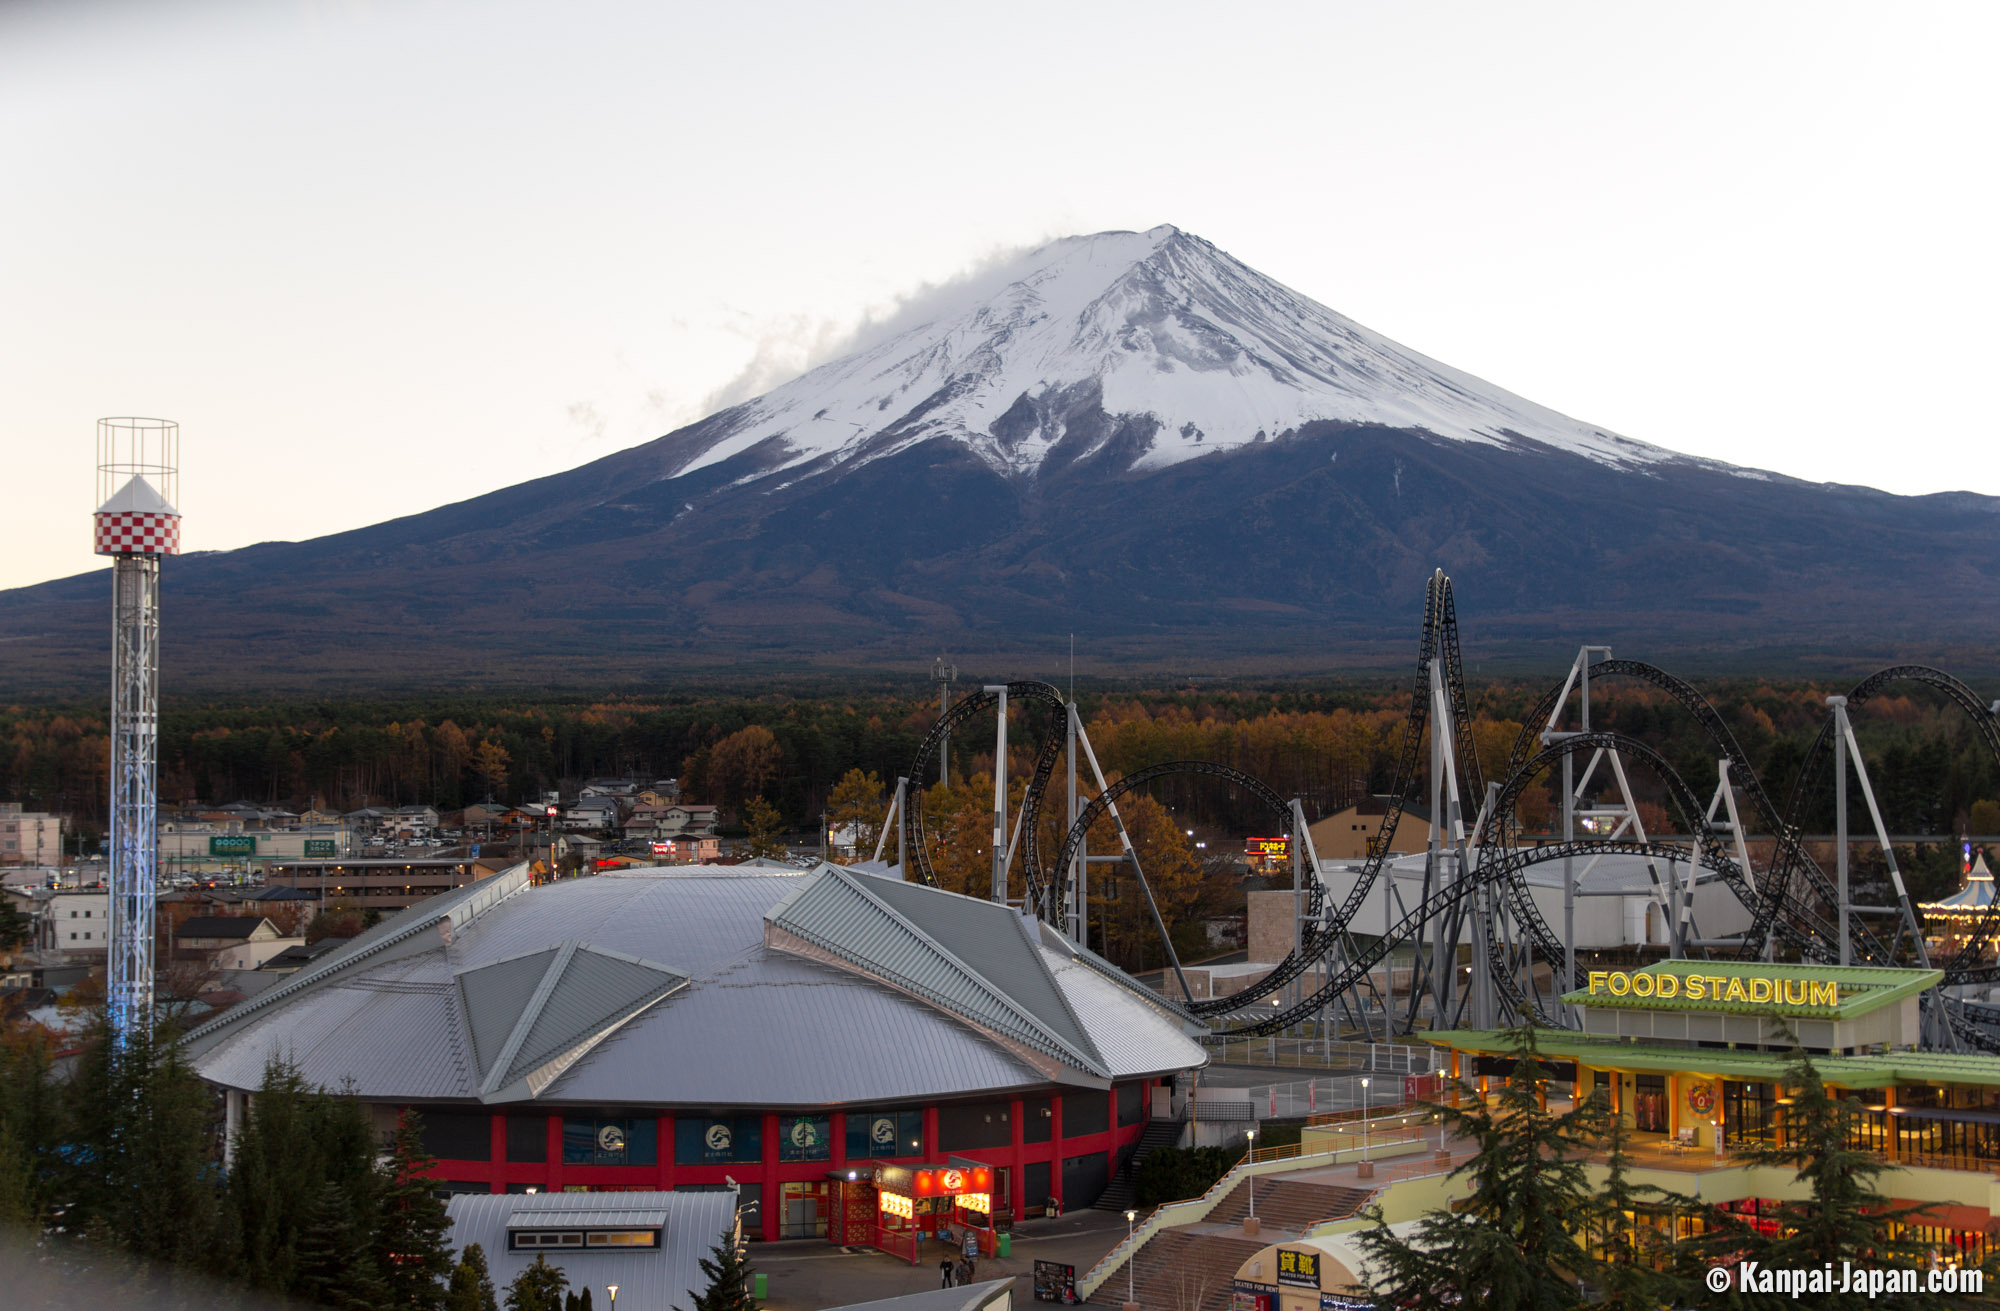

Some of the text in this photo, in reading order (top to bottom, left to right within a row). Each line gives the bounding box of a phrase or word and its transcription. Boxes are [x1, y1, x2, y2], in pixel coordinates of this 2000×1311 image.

[1589, 971, 1838, 1006] FOOD STADIUM
[1234, 1280, 1279, 1294] SKATES FOR RENT
[1322, 1294, 1341, 1302] SKATES
